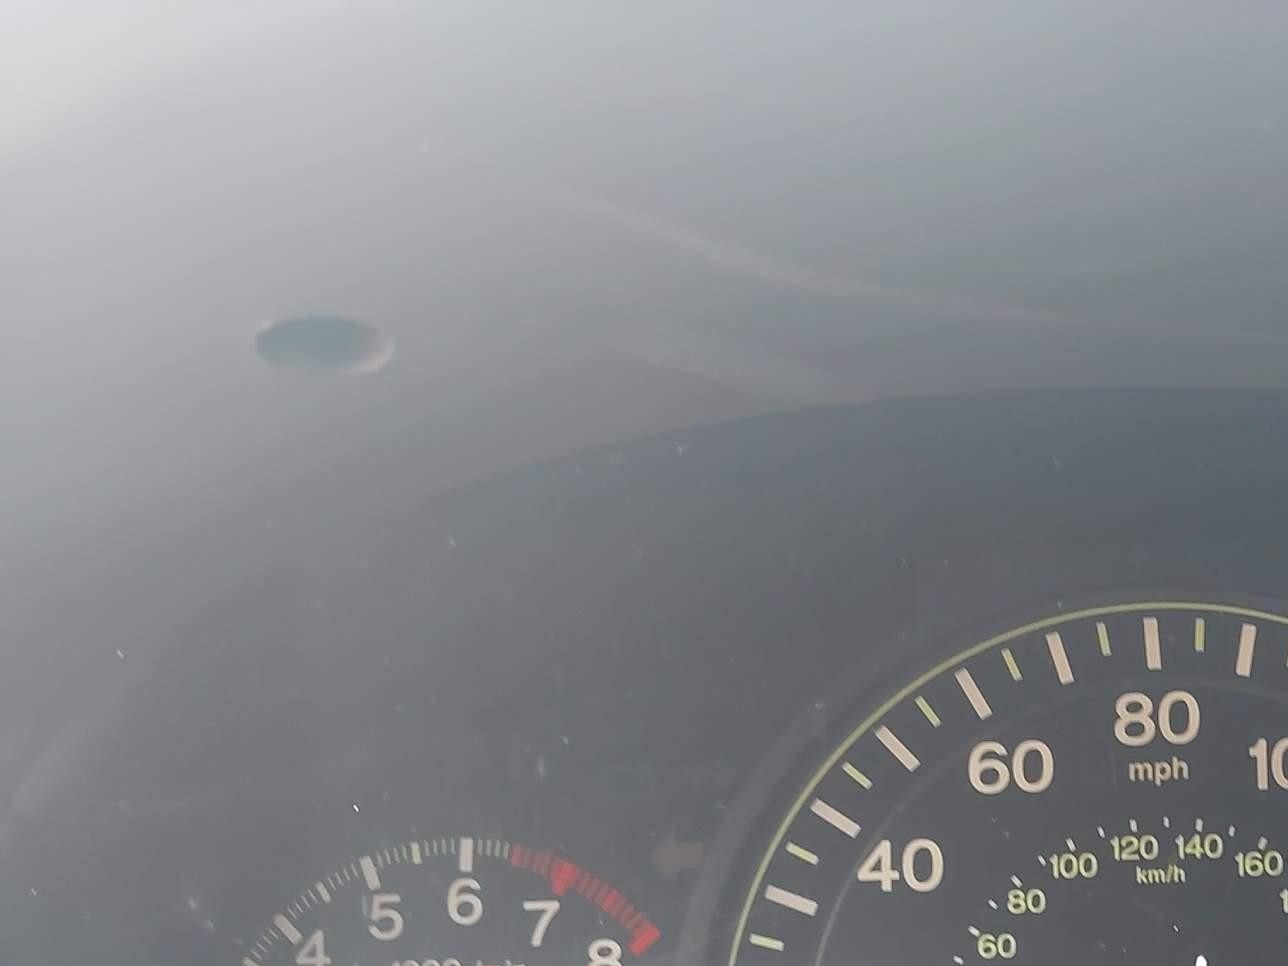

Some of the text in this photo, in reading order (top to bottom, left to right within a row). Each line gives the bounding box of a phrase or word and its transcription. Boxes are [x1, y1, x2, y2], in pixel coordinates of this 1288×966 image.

[1114, 692, 1201, 746] 80
[967, 740, 1055, 794] 60
[1129, 758, 1189, 784] mph
[1110, 834, 1159, 861] 120
[1175, 833, 1224, 859] 140
[857, 838, 944, 892] 40
[1050, 853, 1098, 879] 100
[1136, 865, 1186, 886] km/h
[1235, 851, 1283, 877] 160
[447, 878, 484, 926] 6
[1006, 890, 1046, 915] 80
[368, 893, 404, 940] 5
[523, 900, 560, 947] 7
[977, 934, 1016, 960] 60
